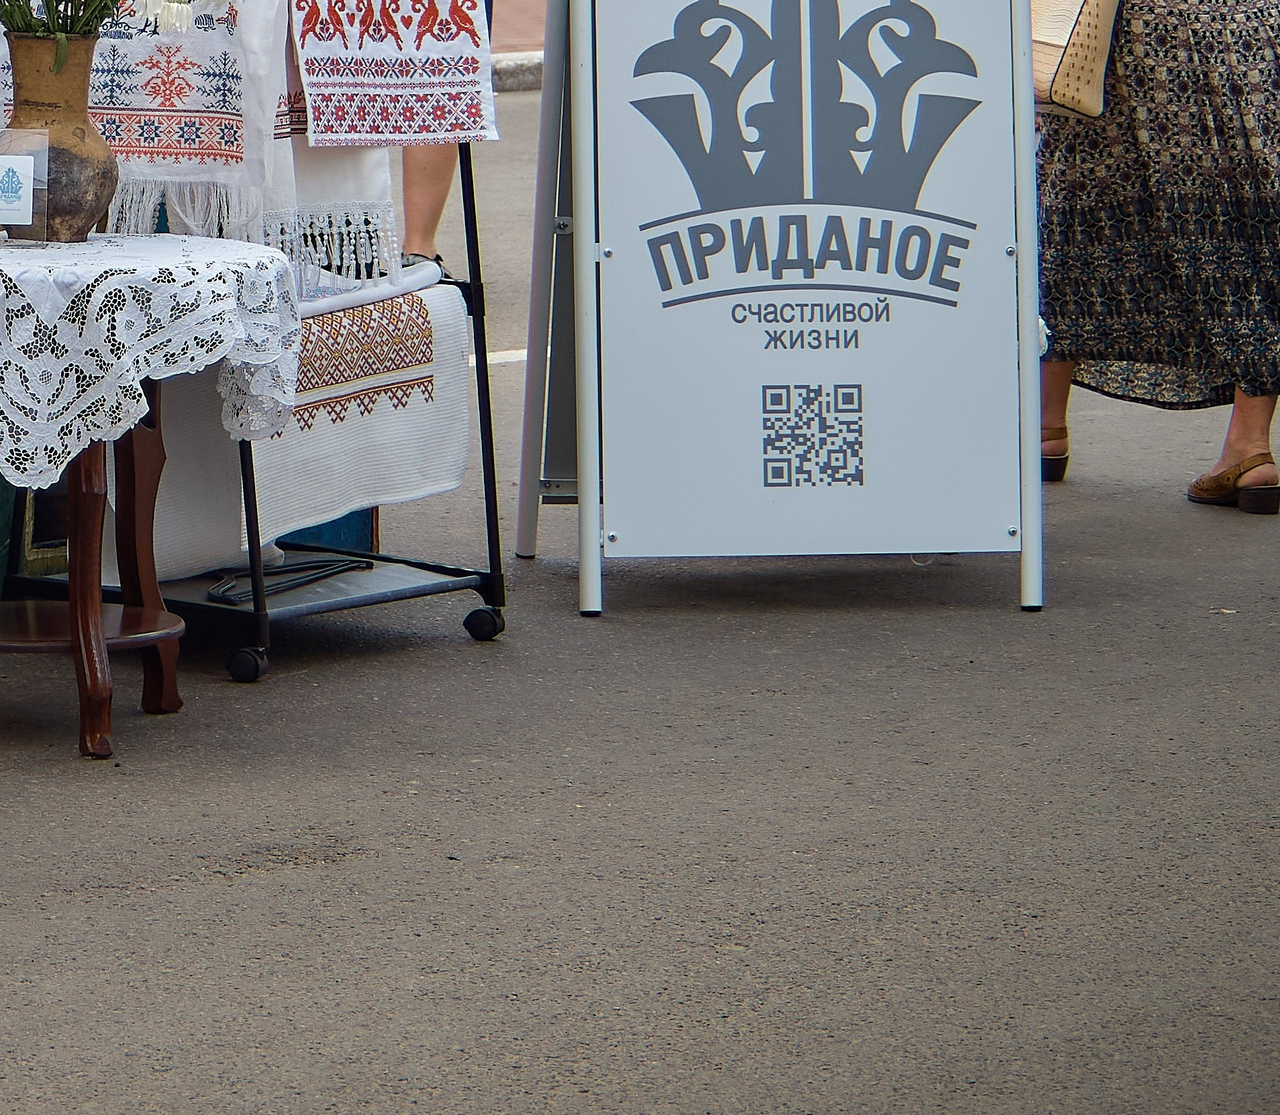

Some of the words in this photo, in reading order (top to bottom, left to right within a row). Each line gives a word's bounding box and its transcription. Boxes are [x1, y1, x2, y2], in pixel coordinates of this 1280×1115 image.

[646, 214, 971, 293] ПРИДАНОЕ
[731, 296, 891, 324] счастливой
[763, 329, 860, 350] жизни
